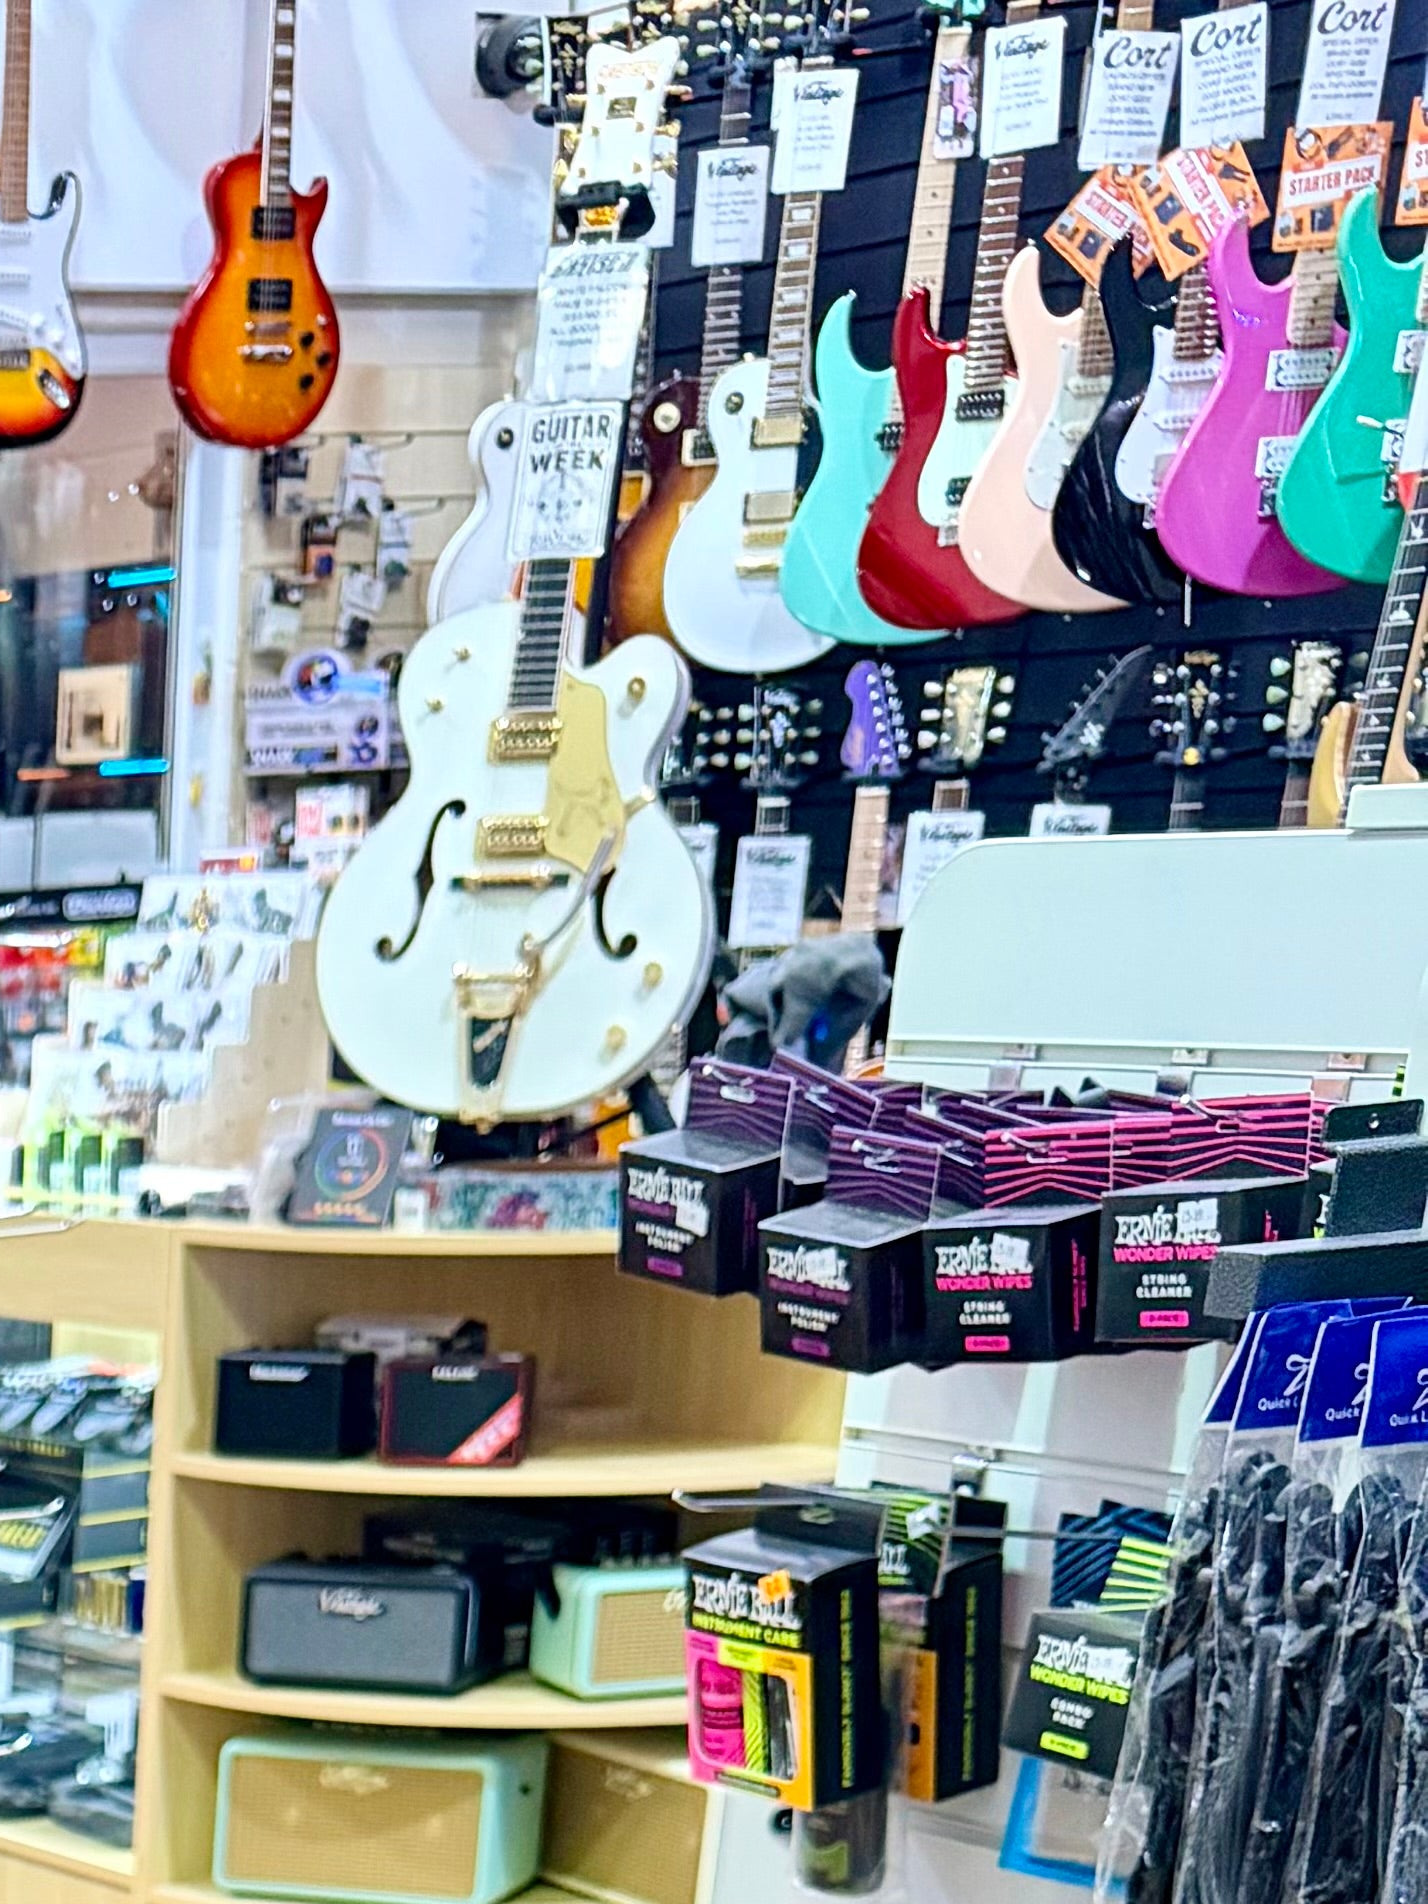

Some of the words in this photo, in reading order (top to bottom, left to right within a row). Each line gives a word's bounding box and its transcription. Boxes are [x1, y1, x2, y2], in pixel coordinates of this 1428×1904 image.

[1318, 1, 1387, 35] Cort
[1191, 14, 1262, 58] Cort
[1103, 36, 1172, 70] Cort
[1290, 172, 1341, 196] STARTER
[1345, 165, 1376, 187] PACK
[531, 412, 611, 444] GUITAR
[530, 449, 605, 474] WEEK
[1115, 1205, 1175, 1245] ERNIE
[766, 1244, 808, 1283] ERNI
[935, 1236, 990, 1277] ERNIE
[1114, 1245, 1174, 1263] WONDER
[1176, 1244, 1220, 1261] WIPES
[936, 1274, 992, 1292] WONDER
[994, 1272, 1034, 1290] WIPES
[1135, 1285, 1194, 1300] CLEANER
[1141, 1273, 1188, 1287] STRING
[958, 1311, 1013, 1326] CLEANER
[963, 1300, 1007, 1314] STRING
[1257, 1397, 1291, 1412] Quick
[1325, 1407, 1360, 1421] Quick
[692, 1572, 749, 1620] ERNIE
[691, 1611, 764, 1643] INSTRUMENT
[763, 1627, 804, 1649] CARE
[1029, 1663, 1086, 1695] WONDER
